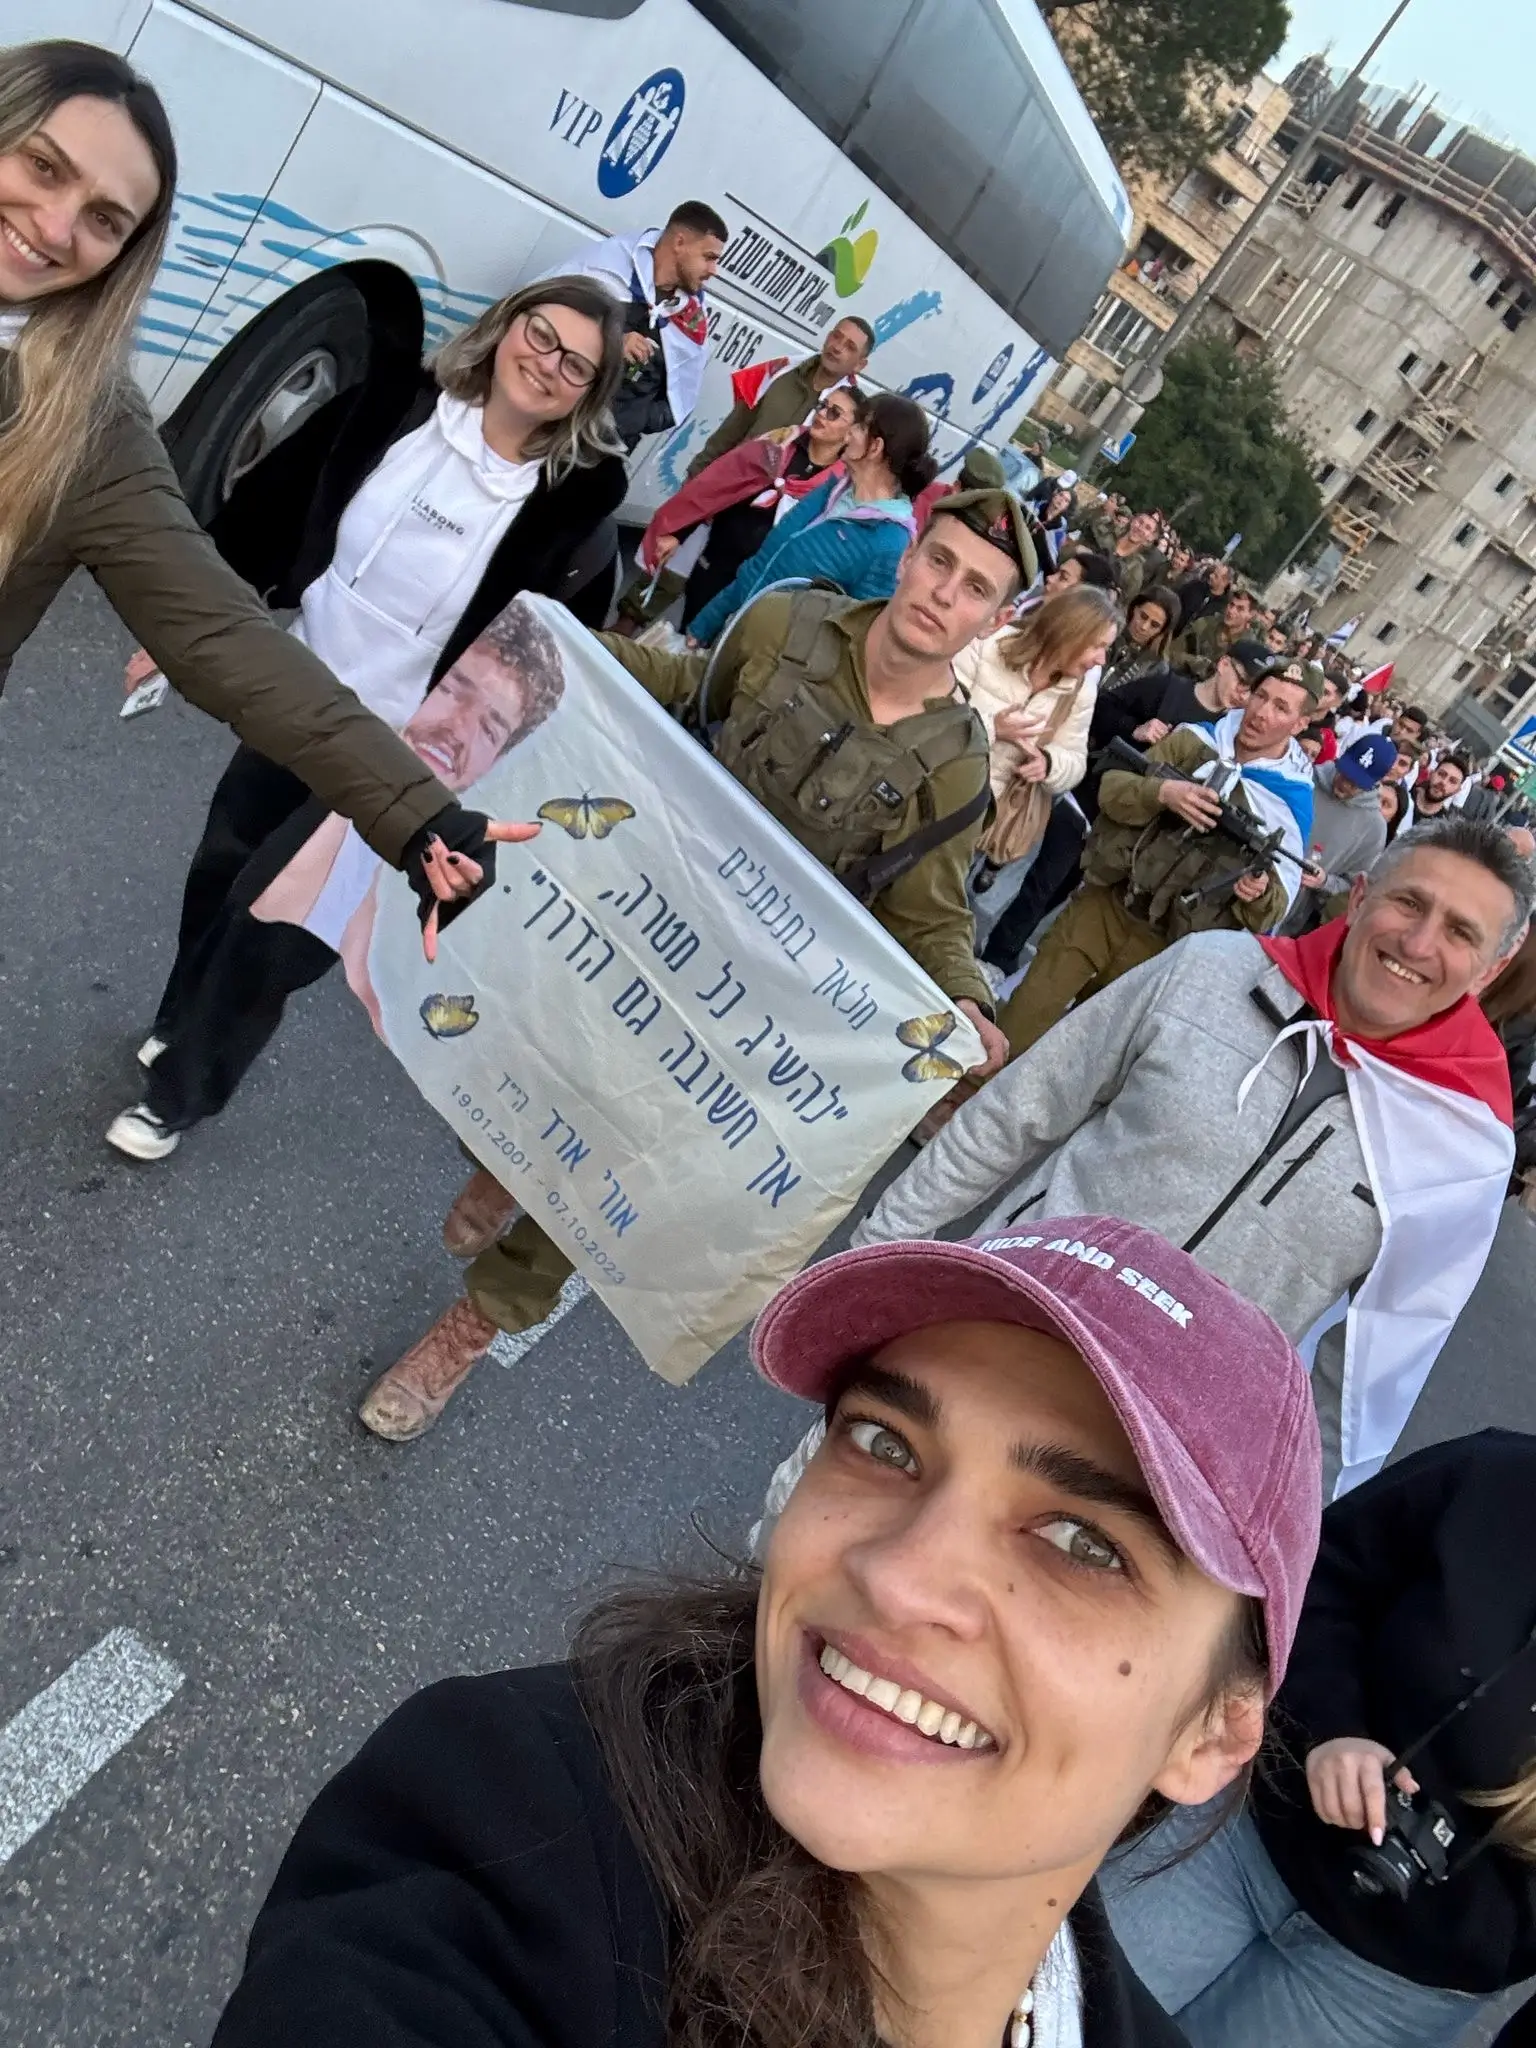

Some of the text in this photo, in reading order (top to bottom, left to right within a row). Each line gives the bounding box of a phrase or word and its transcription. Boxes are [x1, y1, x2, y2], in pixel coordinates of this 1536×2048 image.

[549, 88, 603, 148] VIP
[717, 226, 773, 280] טובה
[751, 249, 805, 302] חמדה
[781, 270, 830, 317] ארץ
[411, 495, 465, 535] LLABONG
[718, 846, 878, 1031] מלאך בתלתלים
[597, 872, 848, 1123] "להשיג כל מטרה,
[613, 976, 661, 1036] גם
[659, 1030, 757, 1149] חשובה
[541, 1108, 591, 1173] ארד
[452, 1085, 533, 1173] 19.01.2001
[547, 1191, 626, 1285] 07.10.2023
[599, 1169, 638, 1238] אורי
[746, 1145, 801, 1208] אך
[980, 1236, 1194, 1330] HIDE AND SEEK
